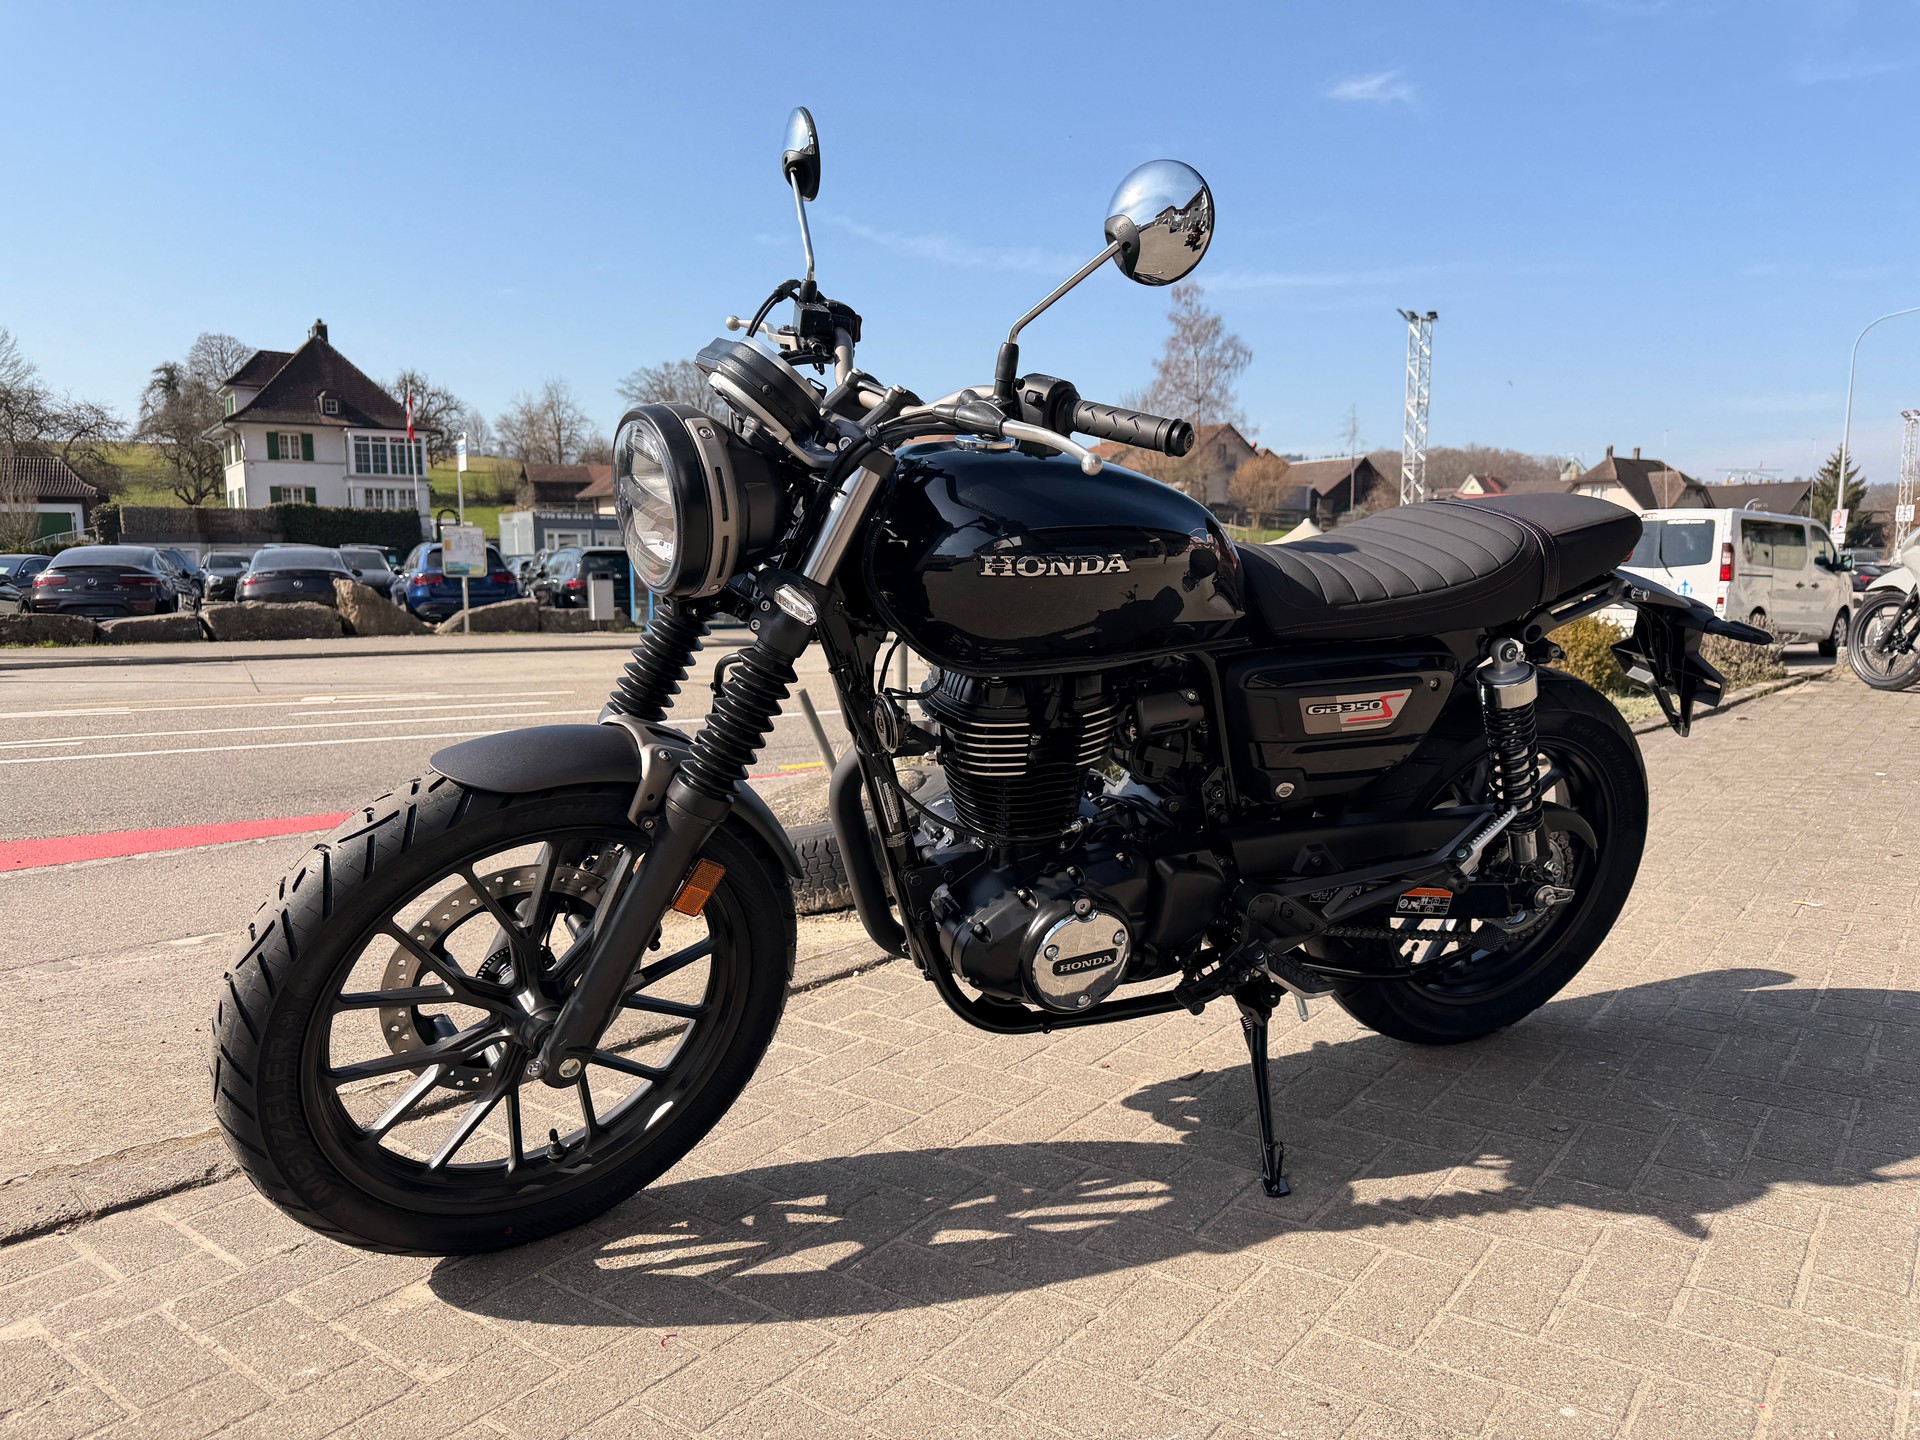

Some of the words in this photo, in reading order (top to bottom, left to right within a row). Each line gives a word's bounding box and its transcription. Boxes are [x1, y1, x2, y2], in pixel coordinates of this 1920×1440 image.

[980, 553, 1131, 577] HONDA
[1059, 955, 1113, 972] HONDA
[266, 1036, 332, 1200] METZELER
